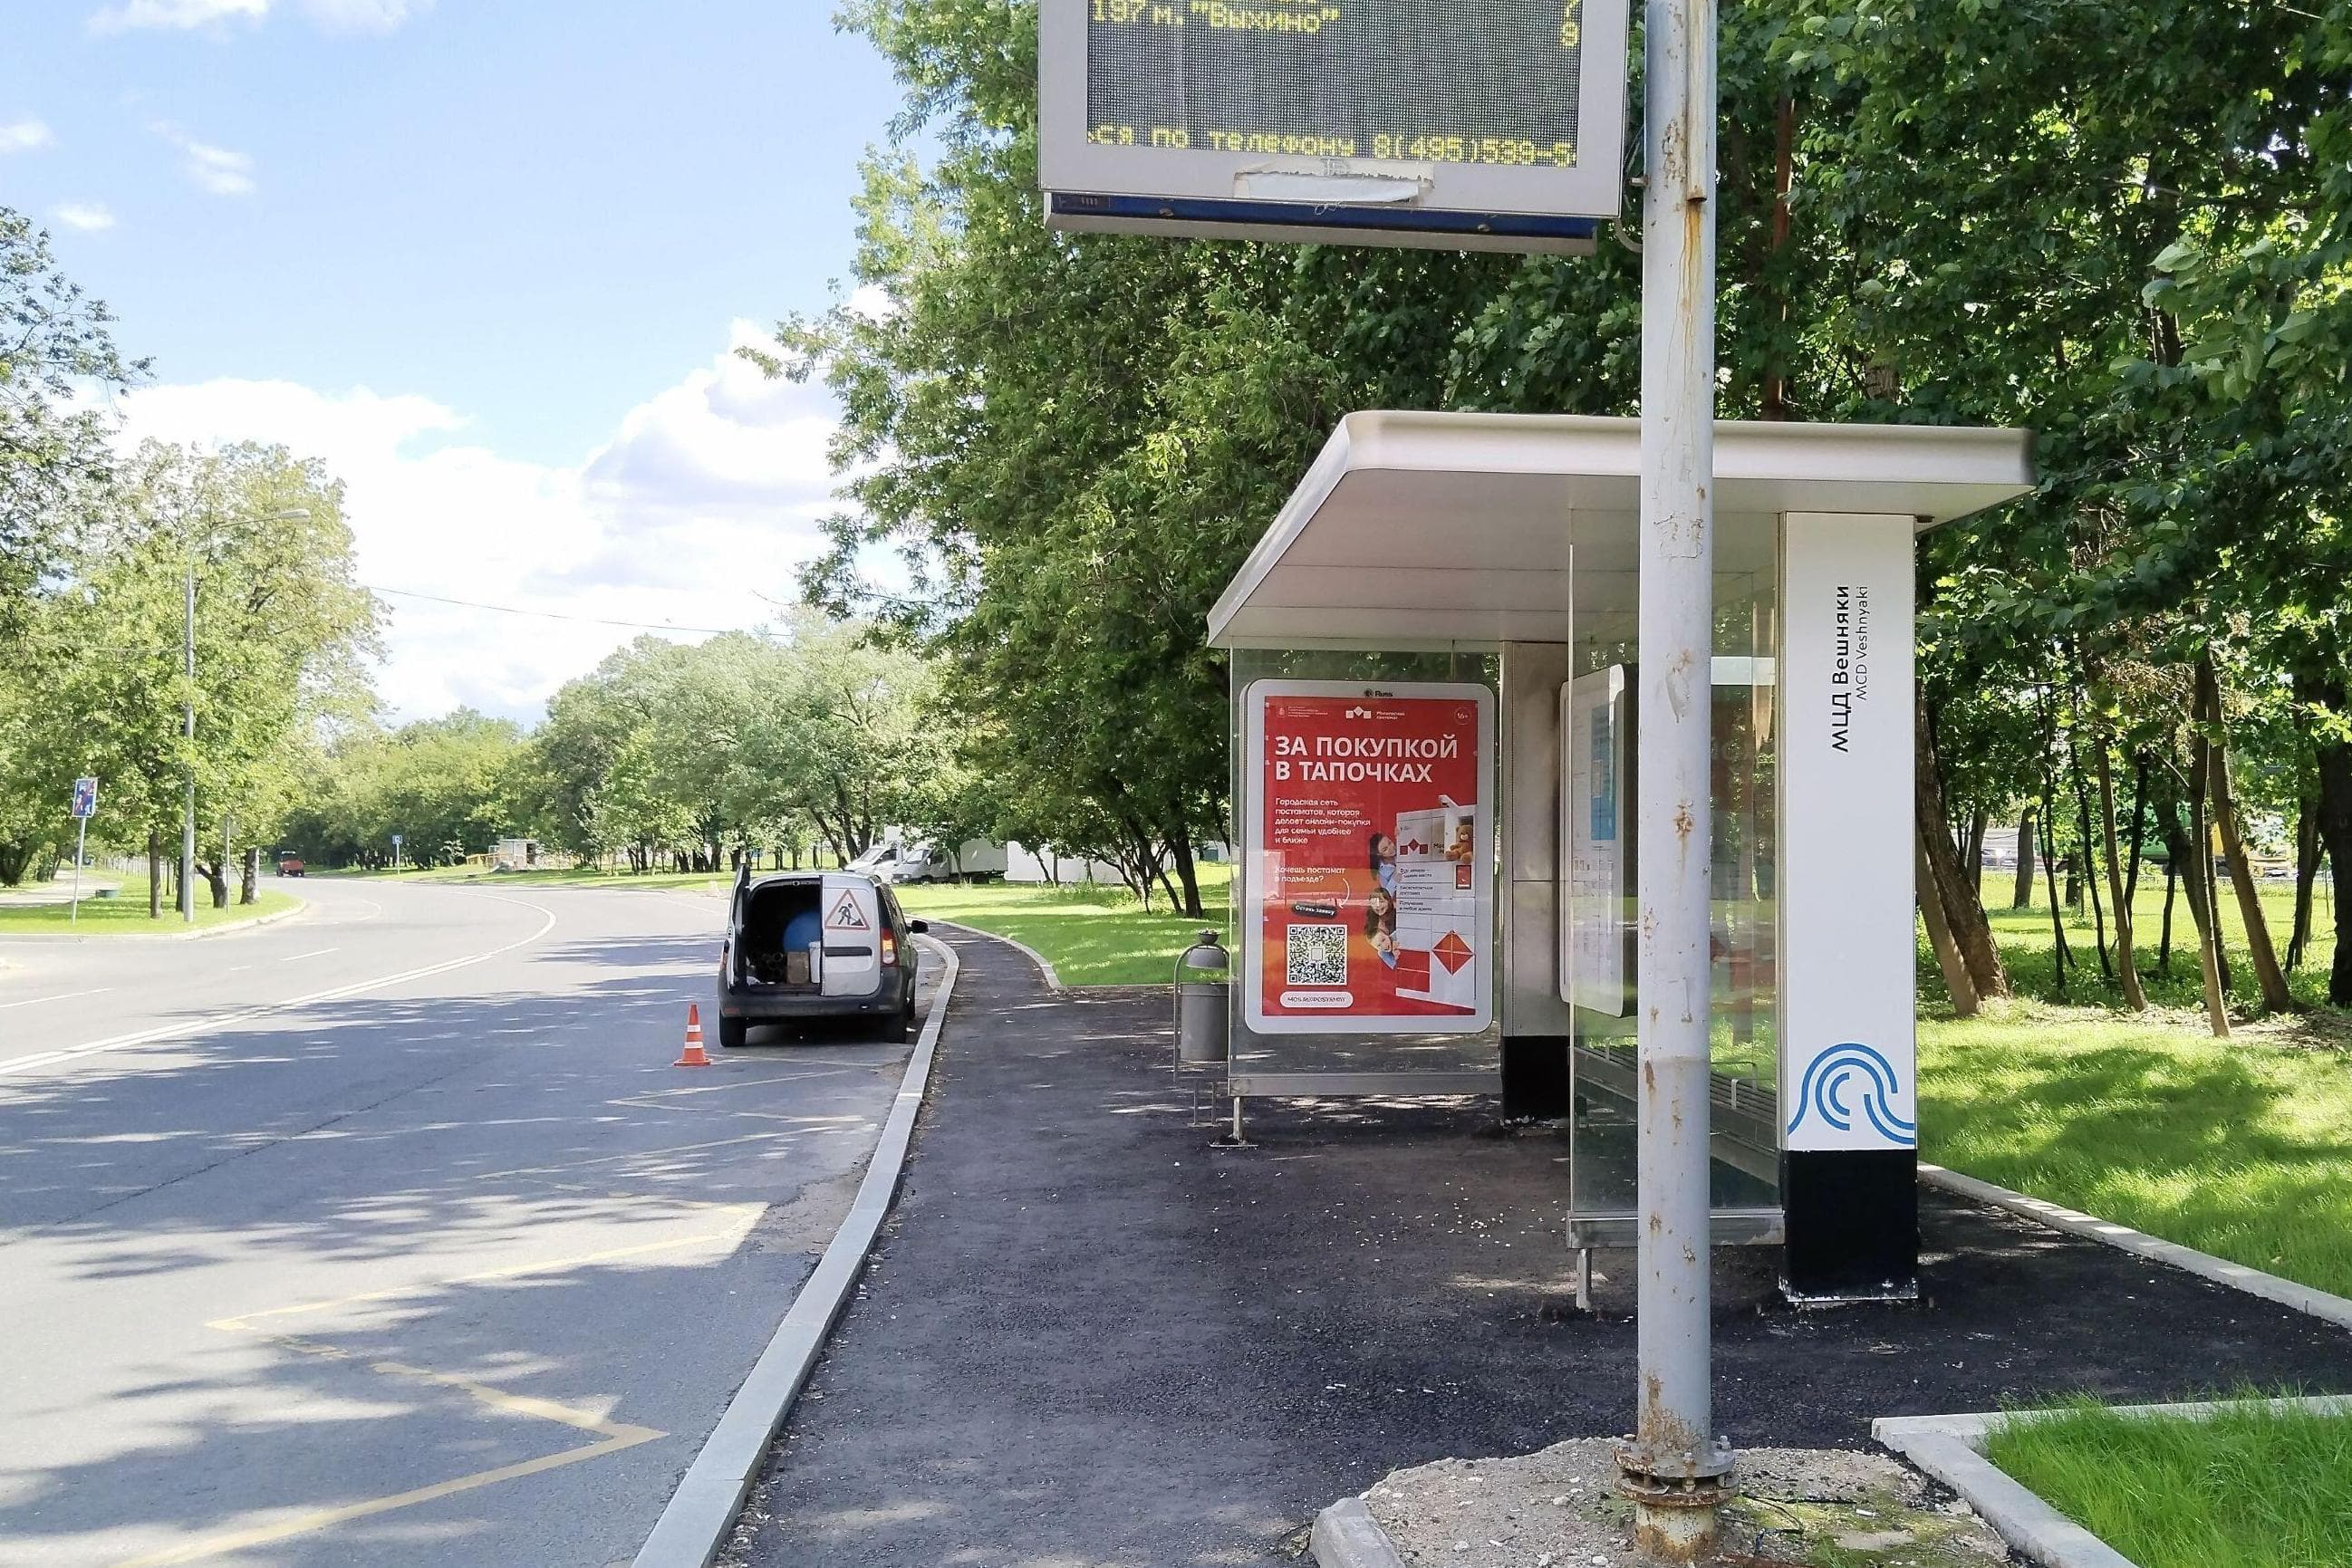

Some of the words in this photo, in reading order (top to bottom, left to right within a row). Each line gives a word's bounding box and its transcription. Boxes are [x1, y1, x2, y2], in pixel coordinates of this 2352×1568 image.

[1152, 128, 1189, 149] по
[1374, 131, 1577, 168] 8(495)539-5
[1832, 585, 1849, 685] Вешняки
[1855, 586, 1871, 660] Veshnyaki
[1856, 663, 1867, 701] MCD
[1832, 692, 1852, 753] МЦД
[1275, 736, 1307, 756] ЗА
[1316, 734, 1458, 759] ПОКУПКОЙ
[1275, 761, 1291, 781] В
[1298, 761, 1433, 783] ТАПОЧКАХ
[1275, 797, 1319, 807] Городская
[1275, 808, 1325, 816] постаматов,
[1282, 836, 1308, 844] ближе
[1306, 867, 1346, 875] постамат
